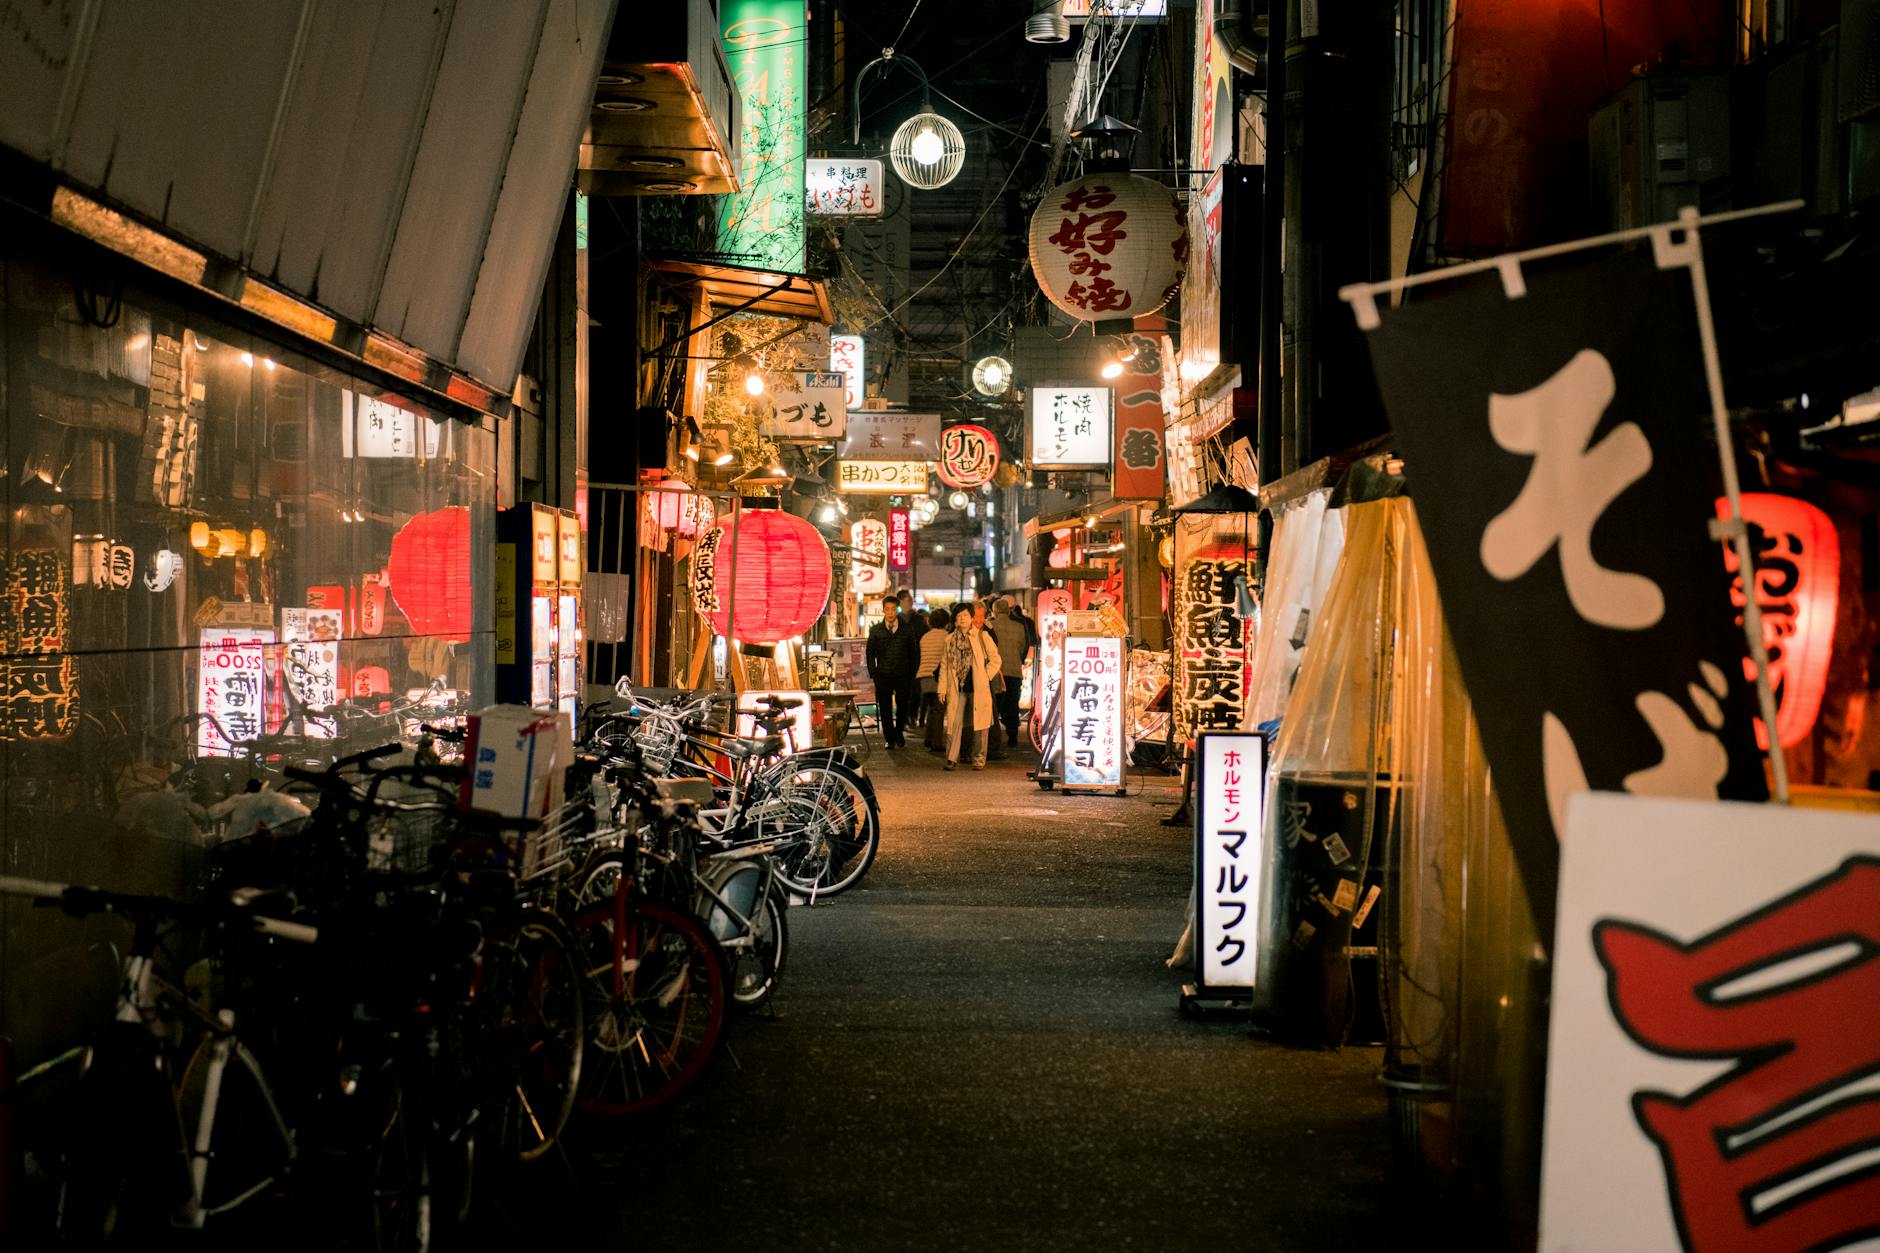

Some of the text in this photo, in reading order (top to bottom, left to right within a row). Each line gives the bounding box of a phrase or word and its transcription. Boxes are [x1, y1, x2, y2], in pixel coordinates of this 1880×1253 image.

[826, 166, 867, 179] 串料理
[1048, 185, 1132, 312] お好み焼
[1053, 392, 1069, 459] ホルモン
[1072, 392, 1094, 436] 焼肉
[842, 464, 898, 483] 串かつ
[875, 527, 884, 563] 大阪名
[892, 513, 907, 566] 営業中
[1068, 646, 1099, 659] 一皿
[1071, 677, 1099, 768] 雷寿司
[1223, 750, 1241, 823] ホルモン
[1217, 829, 1248, 967] マルフク
